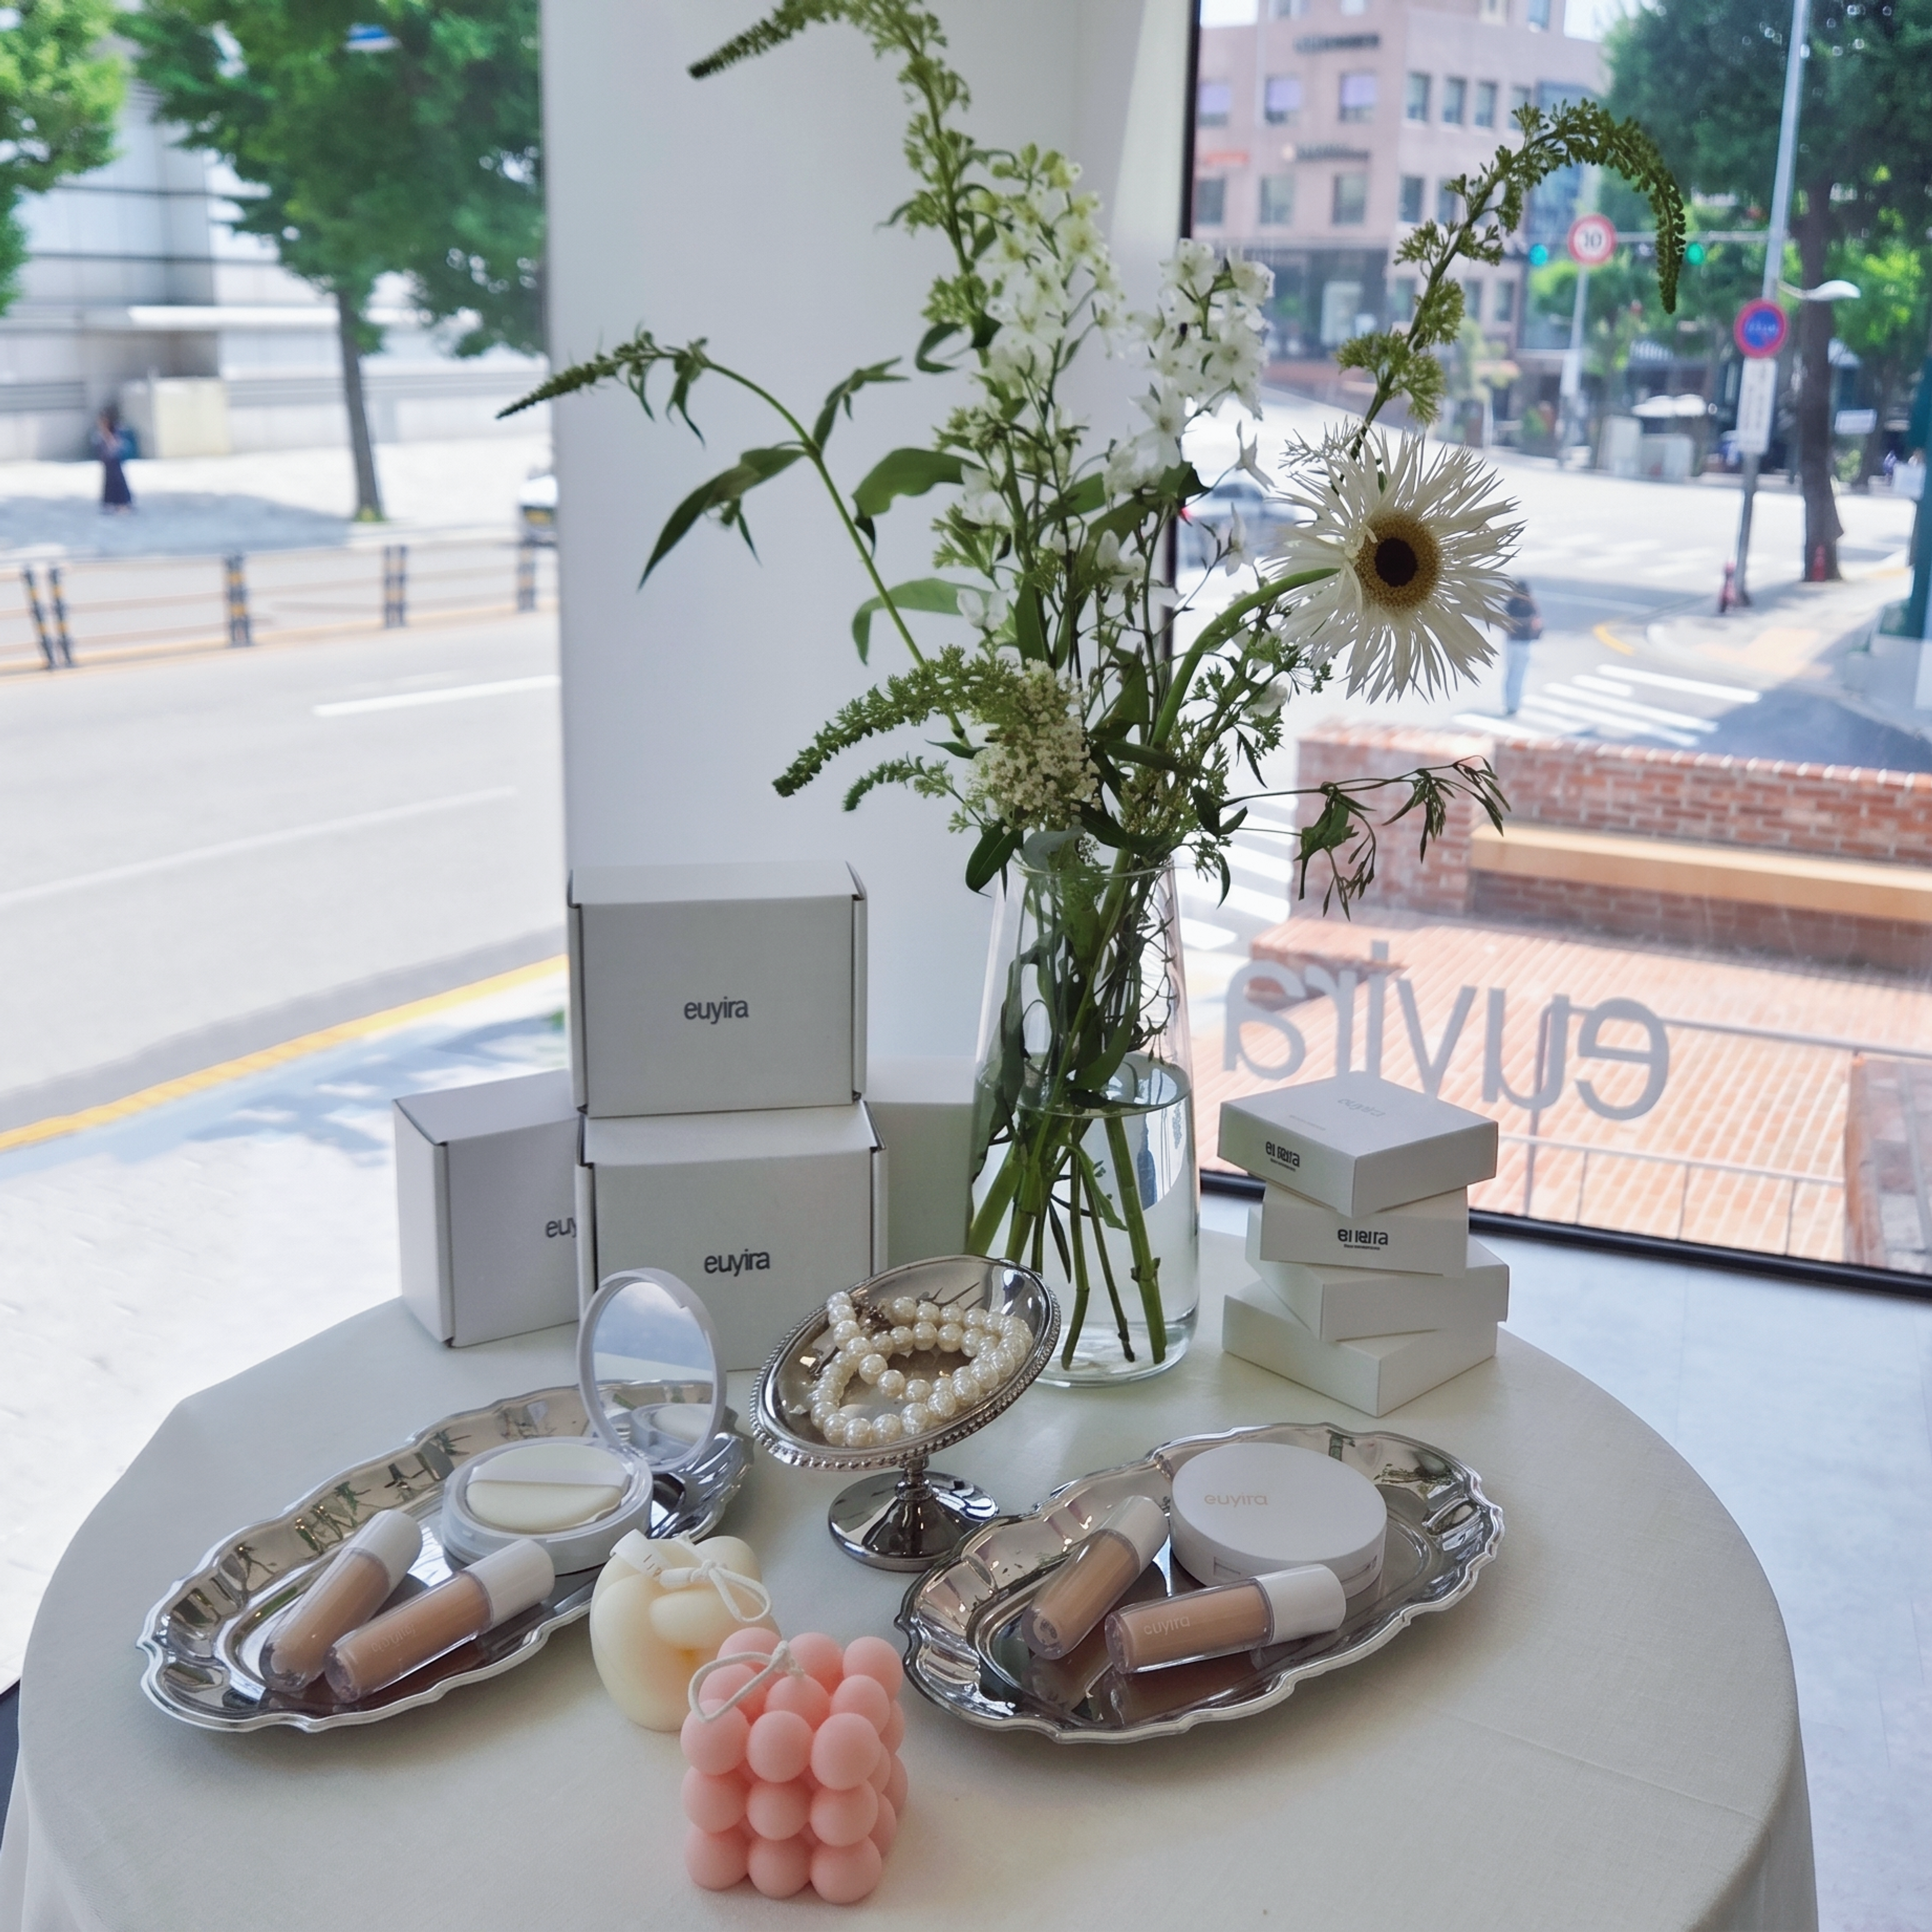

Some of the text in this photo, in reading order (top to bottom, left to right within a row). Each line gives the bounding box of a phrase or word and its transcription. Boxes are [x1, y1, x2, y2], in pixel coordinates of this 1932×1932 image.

[684, 996, 749, 1025] euyira
[704, 1248, 771, 1277] euyira
[1203, 1492, 1268, 1508] euyira
